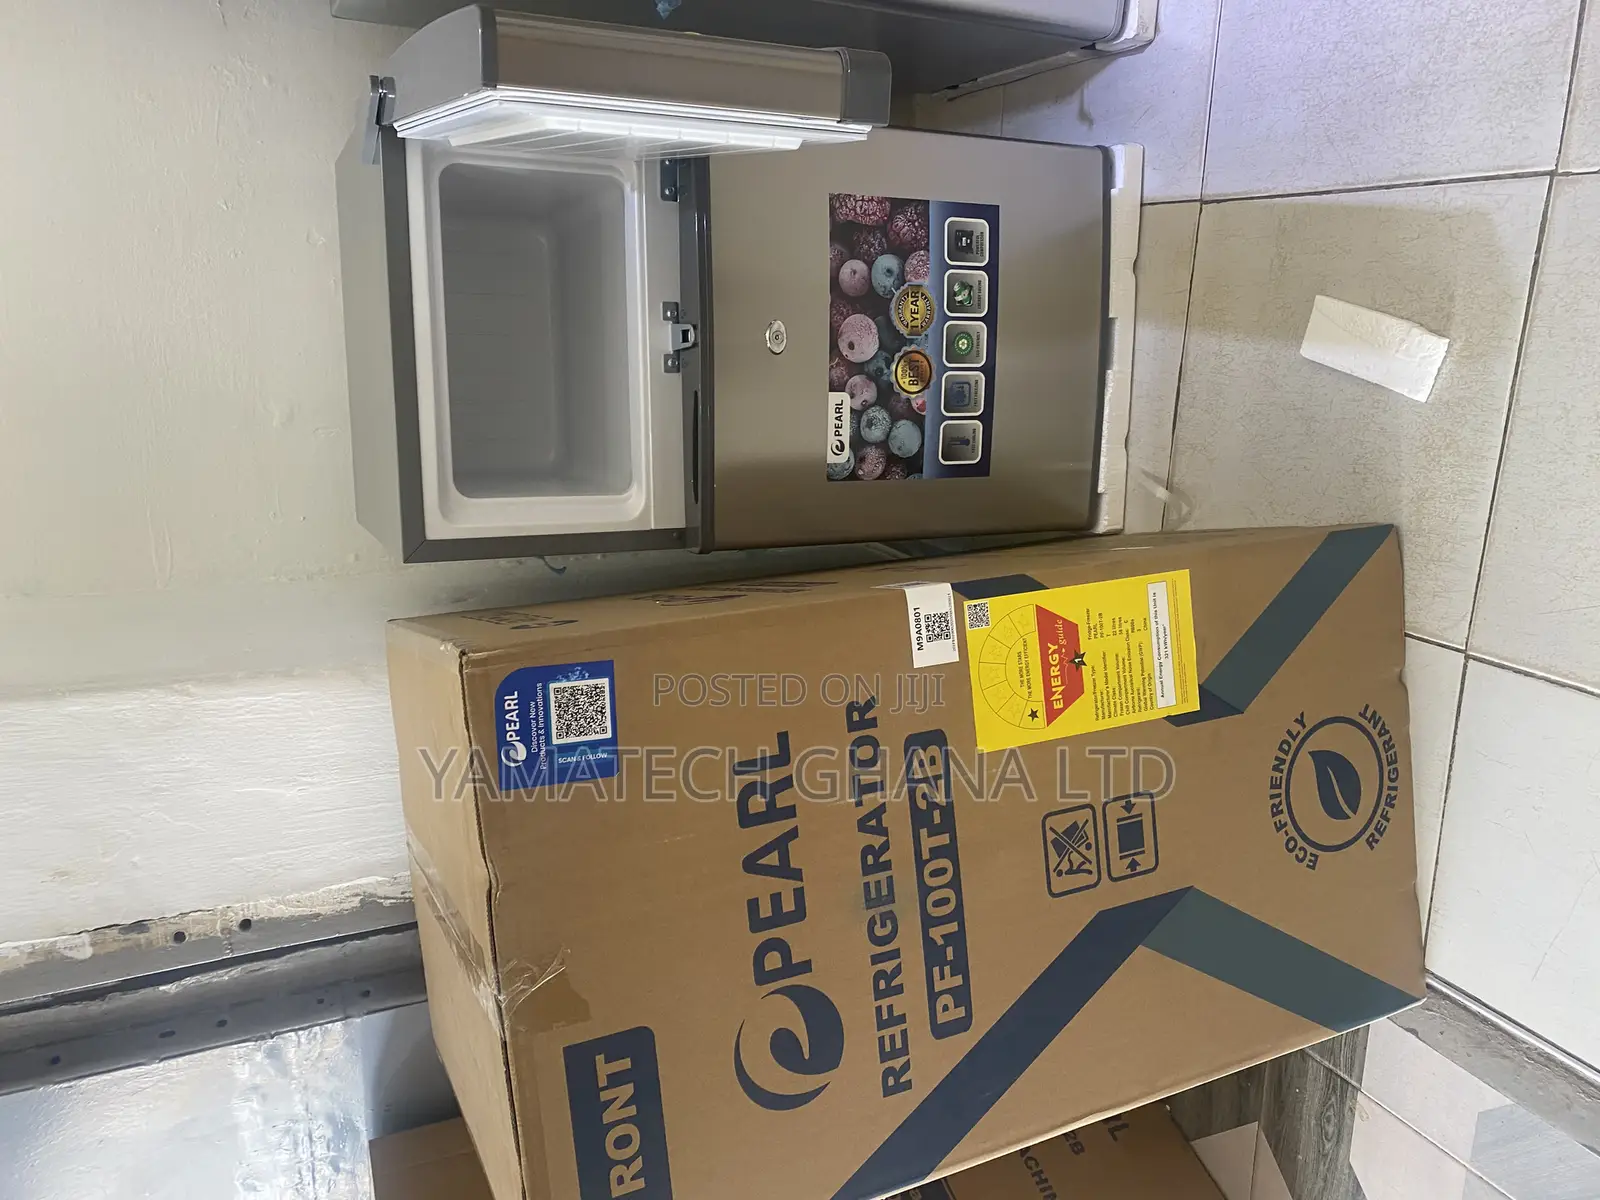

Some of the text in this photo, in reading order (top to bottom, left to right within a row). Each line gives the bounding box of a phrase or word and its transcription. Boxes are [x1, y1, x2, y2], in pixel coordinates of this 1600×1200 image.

[898, 294, 908, 326] WARRANTY
[920, 294, 932, 328] WARRANTY
[900, 362, 908, 380] 100%
[908, 359, 920, 386] BEST
[834, 399, 844, 437] PEARL
[913, 607, 924, 651] M9A0801
[1055, 619, 1068, 645] guide
[1085, 607, 1093, 640] Fridge-Freezer
[1154, 626, 1162, 661] Consumption
[1048, 642, 1066, 710] ENERGY
[1122, 674, 1130, 705] Compartment
[504, 690, 520, 741] PEARL
[535, 682, 544, 728] Innovations
[530, 720, 538, 753] Discover
[538, 735, 547, 770] Products
[558, 756, 576, 764] SCAN
[1358, 703, 1400, 850] REFRIGERANT
[1269, 711, 1320, 871] ECO-FRIENDLY
[732, 730, 812, 987] PEARL
[845, 695, 912, 1098] REFRIGERATOR
[913, 745, 967, 1025] PF-100T-2B
